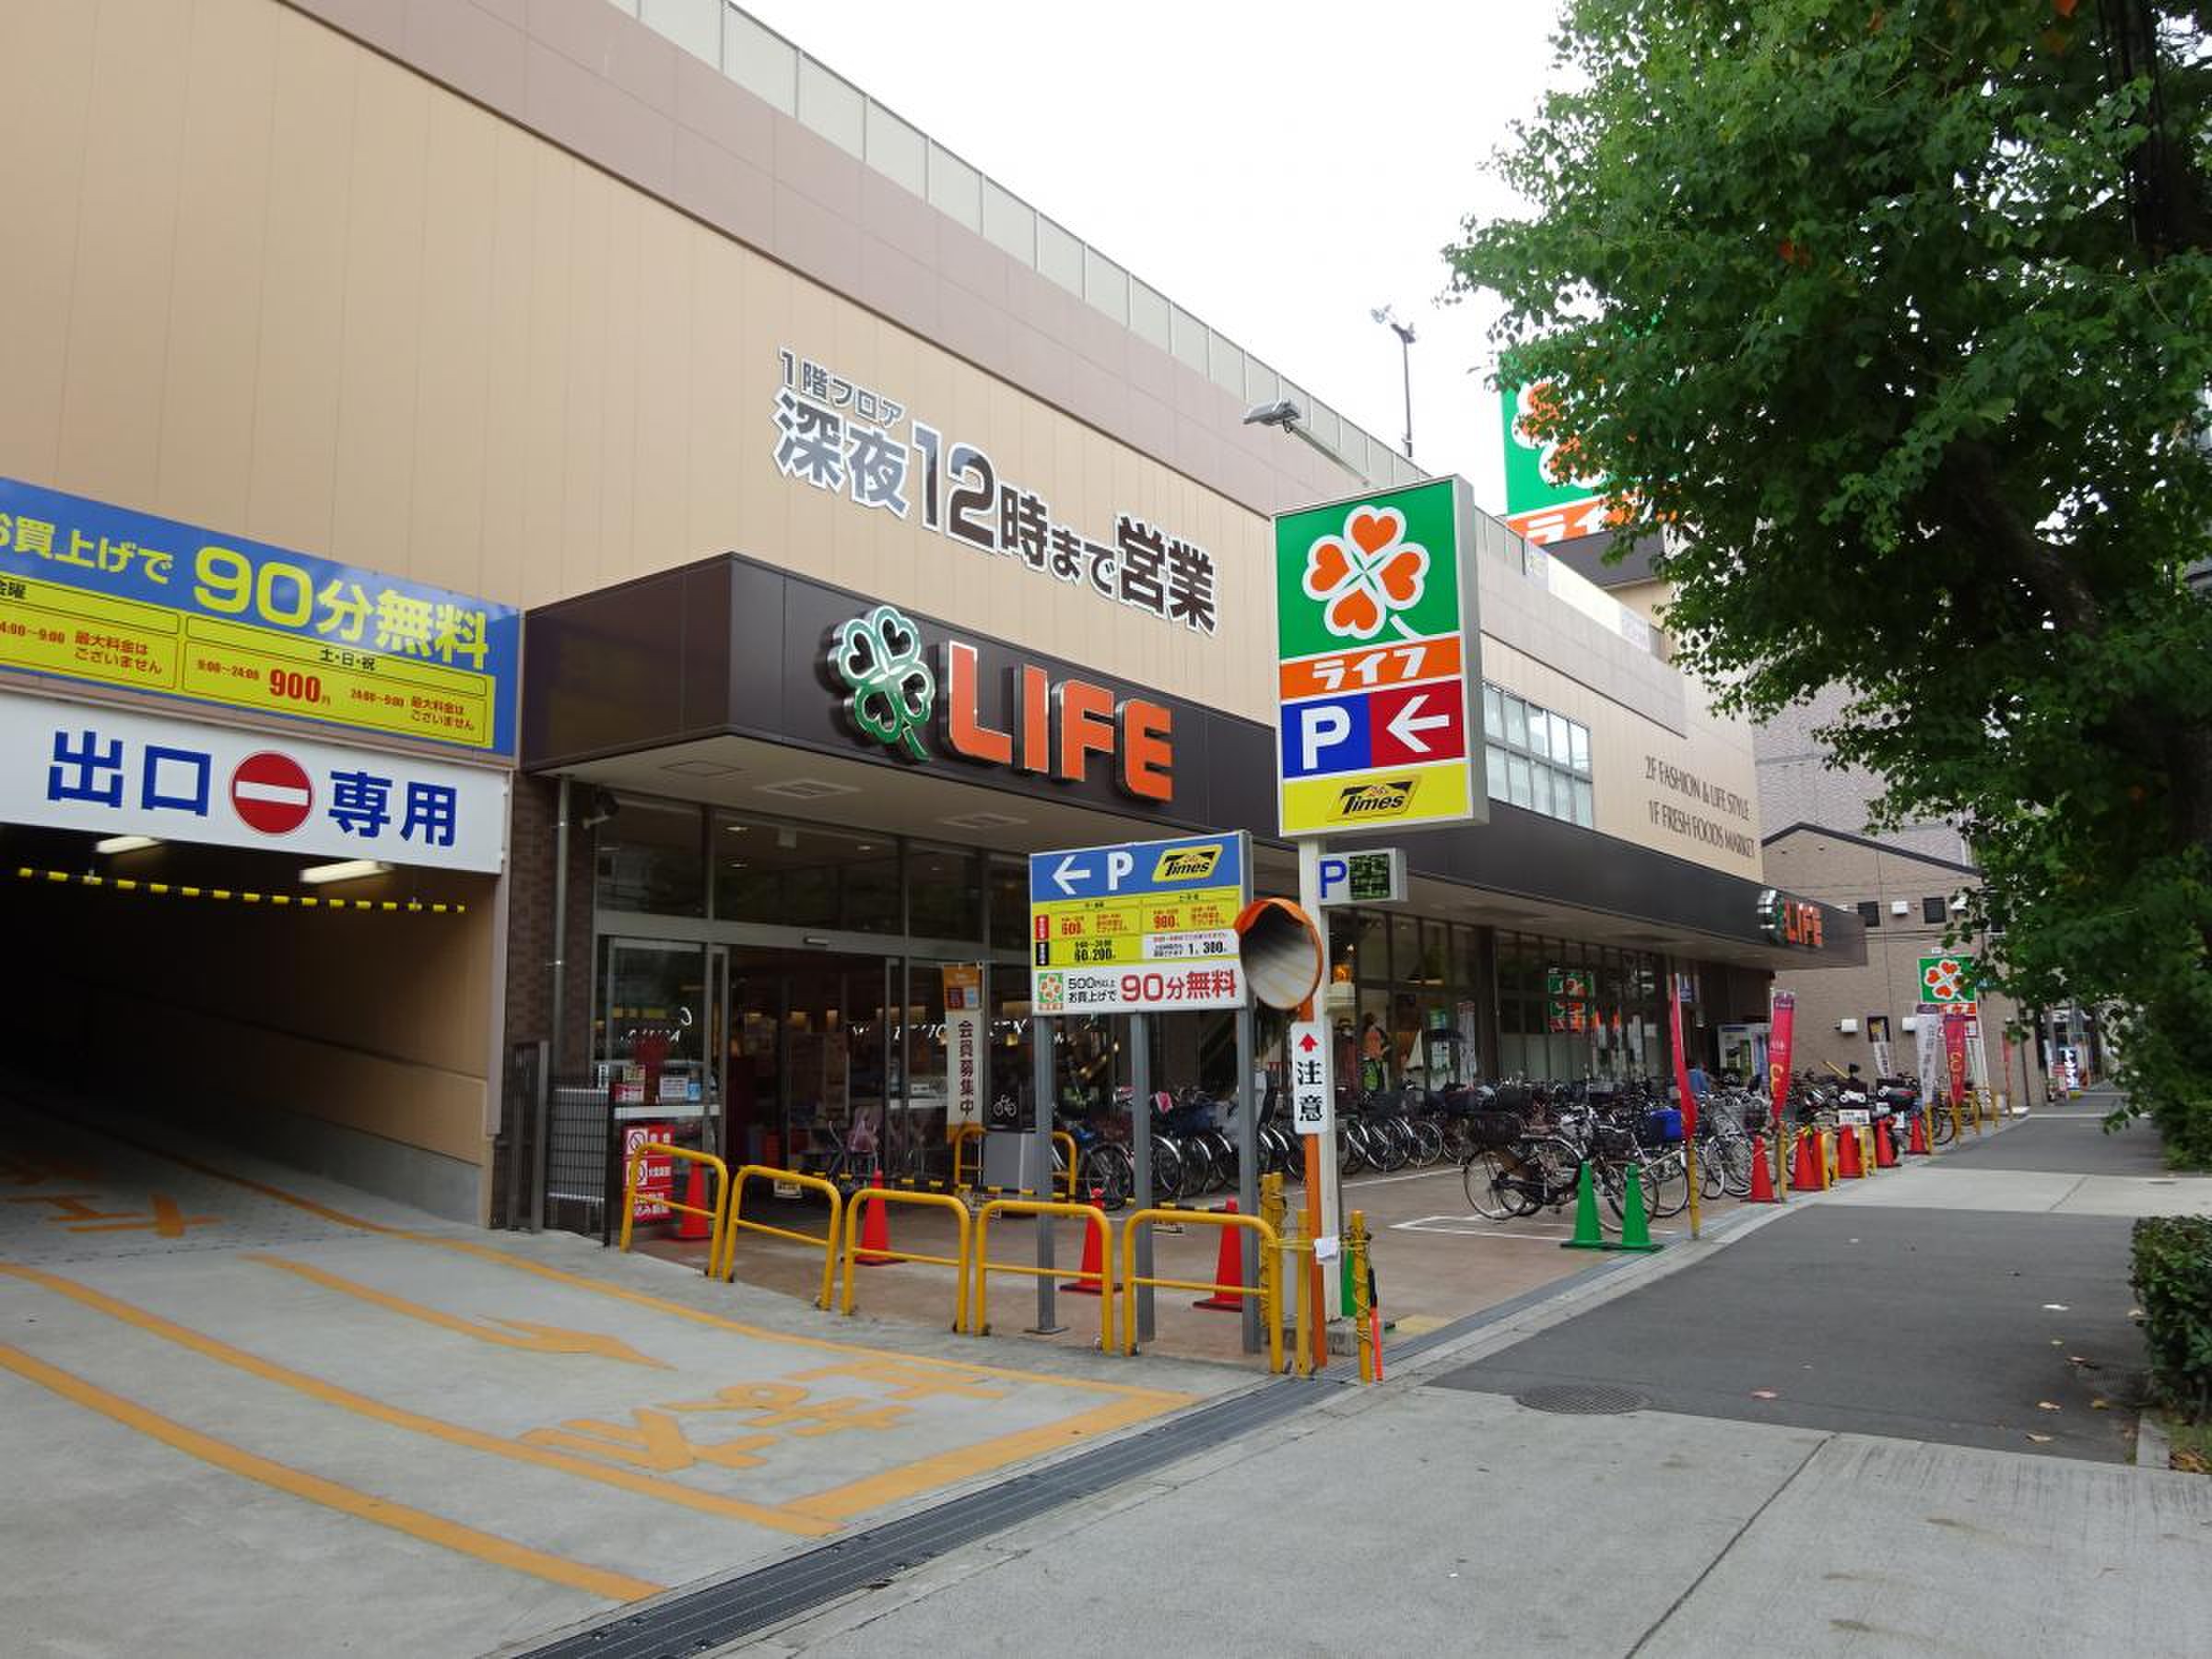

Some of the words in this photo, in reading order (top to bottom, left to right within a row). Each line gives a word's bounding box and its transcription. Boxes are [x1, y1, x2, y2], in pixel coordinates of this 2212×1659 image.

[779, 350, 903, 428] 1階フロア
[772, 388, 1218, 635] 深夜12時まで営業
[193, 546, 489, 670] 90分無料
[1312, 646, 1428, 691] ライフ
[947, 640, 1174, 801] LIFE
[1300, 705, 1351, 771] P
[46, 730, 213, 818] 出口
[327, 769, 458, 847] 専用
[1342, 783, 1407, 815] Times
[1644, 755, 1657, 782] 2F
[1658, 759, 1701, 798] FASHION
[1649, 800, 1660, 825] 1F
[1662, 804, 1692, 837] FRESH
[1691, 816, 1724, 849] FOODS
[1108, 851, 1134, 890] P
[1164, 854, 1211, 877] Times
[1319, 860, 1347, 900] P
[1120, 969, 1238, 1003] 90分無料
[957, 1019, 974, 1116] 会員募集中
[1297, 1059, 1323, 1122] 注意
